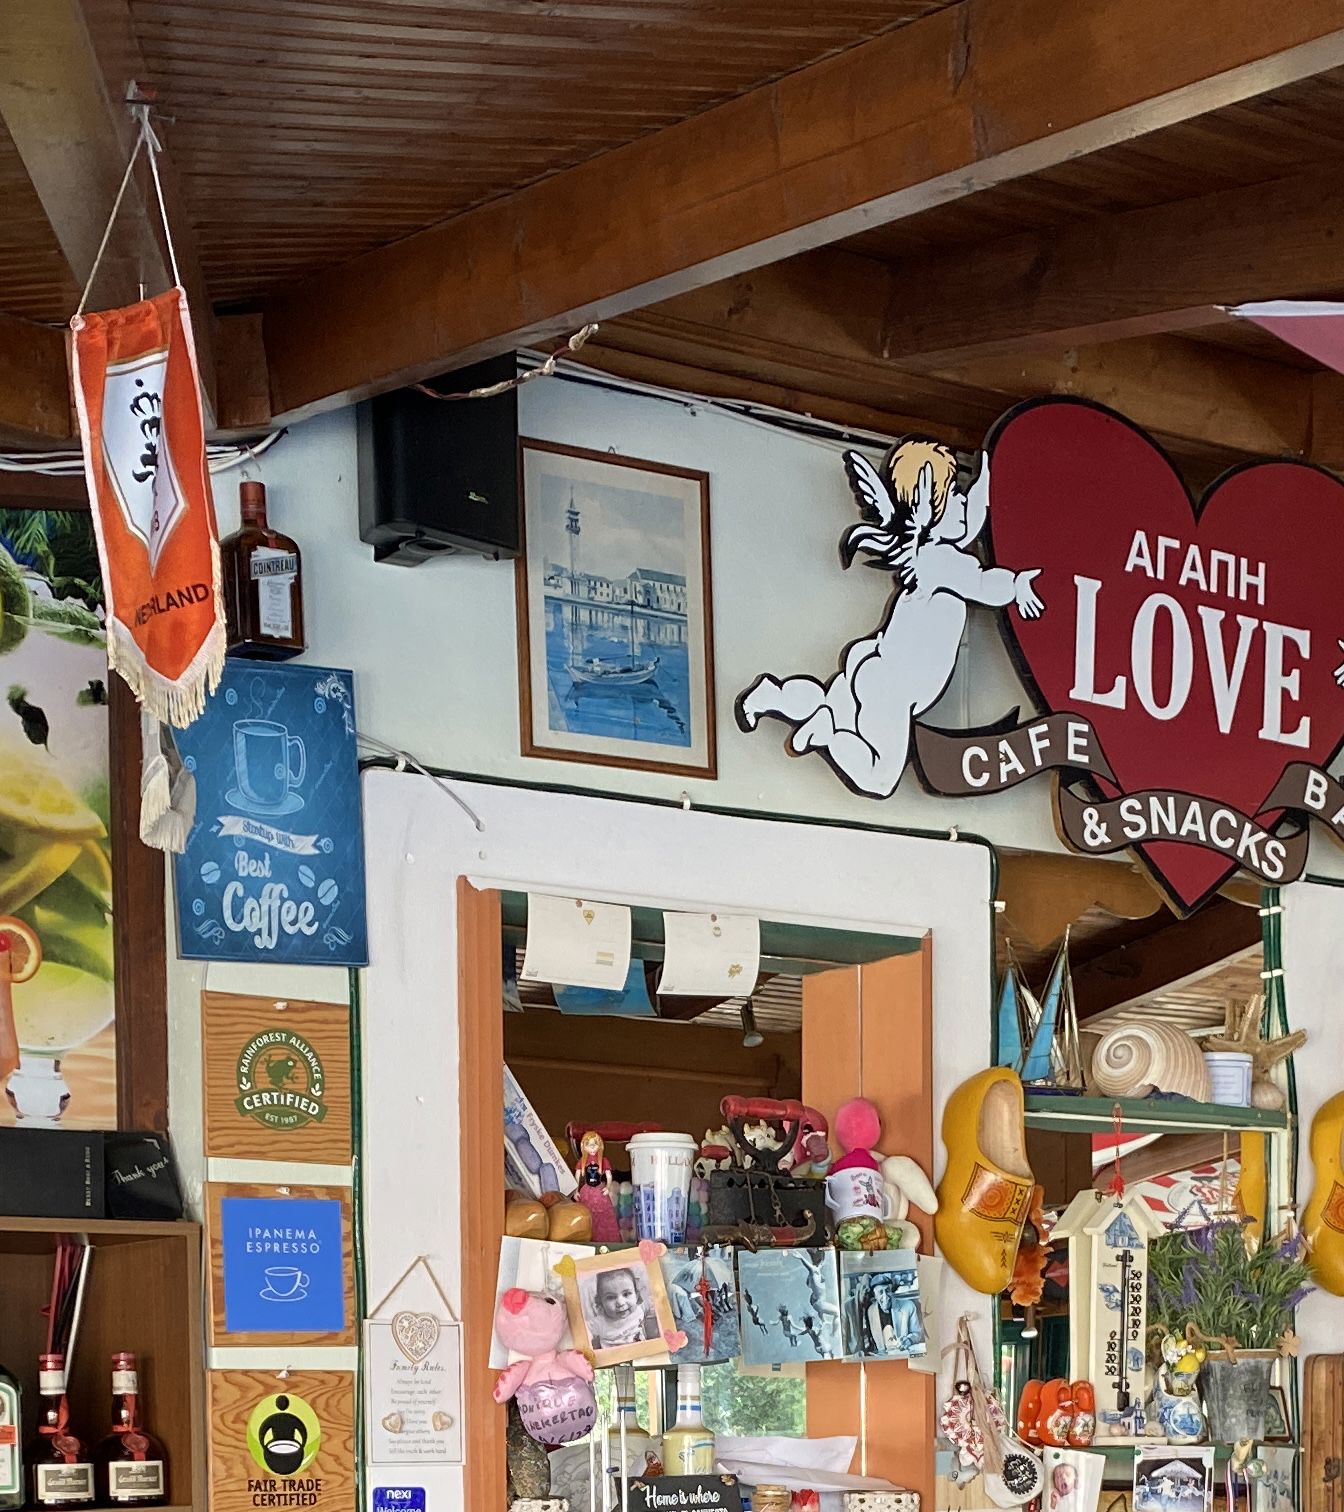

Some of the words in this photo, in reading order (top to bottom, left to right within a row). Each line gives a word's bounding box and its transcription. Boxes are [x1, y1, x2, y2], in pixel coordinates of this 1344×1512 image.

[253, 558, 295, 576] COINTREAU
[1124, 528, 1268, 606] ΑΓΑΠΗ
[1069, 574, 1312, 751] LOVE
[960, 720, 1093, 789] CAFE
[1081, 807, 1113, 849] &
[1120, 793, 1290, 877] SNACKS
[235, 850, 272, 877] Best
[222, 881, 319, 950] Coffee
[240, 1032, 288, 1074] RAINFOREST
[289, 1036, 323, 1081] ALLIANCE
[243, 1090, 320, 1116] CERTIFIED
[265, 1113, 280, 1123] EST
[526, 1112, 546, 1141] Fryske
[111, 1165, 145, 1185] Thank
[248, 1227, 317, 1240] IPANEMA
[246, 1242, 321, 1254] ESPRESSO
[1130, 1270, 1143, 1280] 50
[1130, 1306, 1142, 1317] 20
[1105, 1353, 1117, 1363] 20
[390, 1360, 419, 1376] Family
[247, 1479, 278, 1493] FAIR
[280, 1478, 323, 1492] TRADE
[386, 1489, 412, 1500] nexi
[252, 1492, 318, 1507] CERTIFIED
[640, 1485, 679, 1508] Home
[679, 1492, 689, 1505] is
[689, 1485, 721, 1505] where
